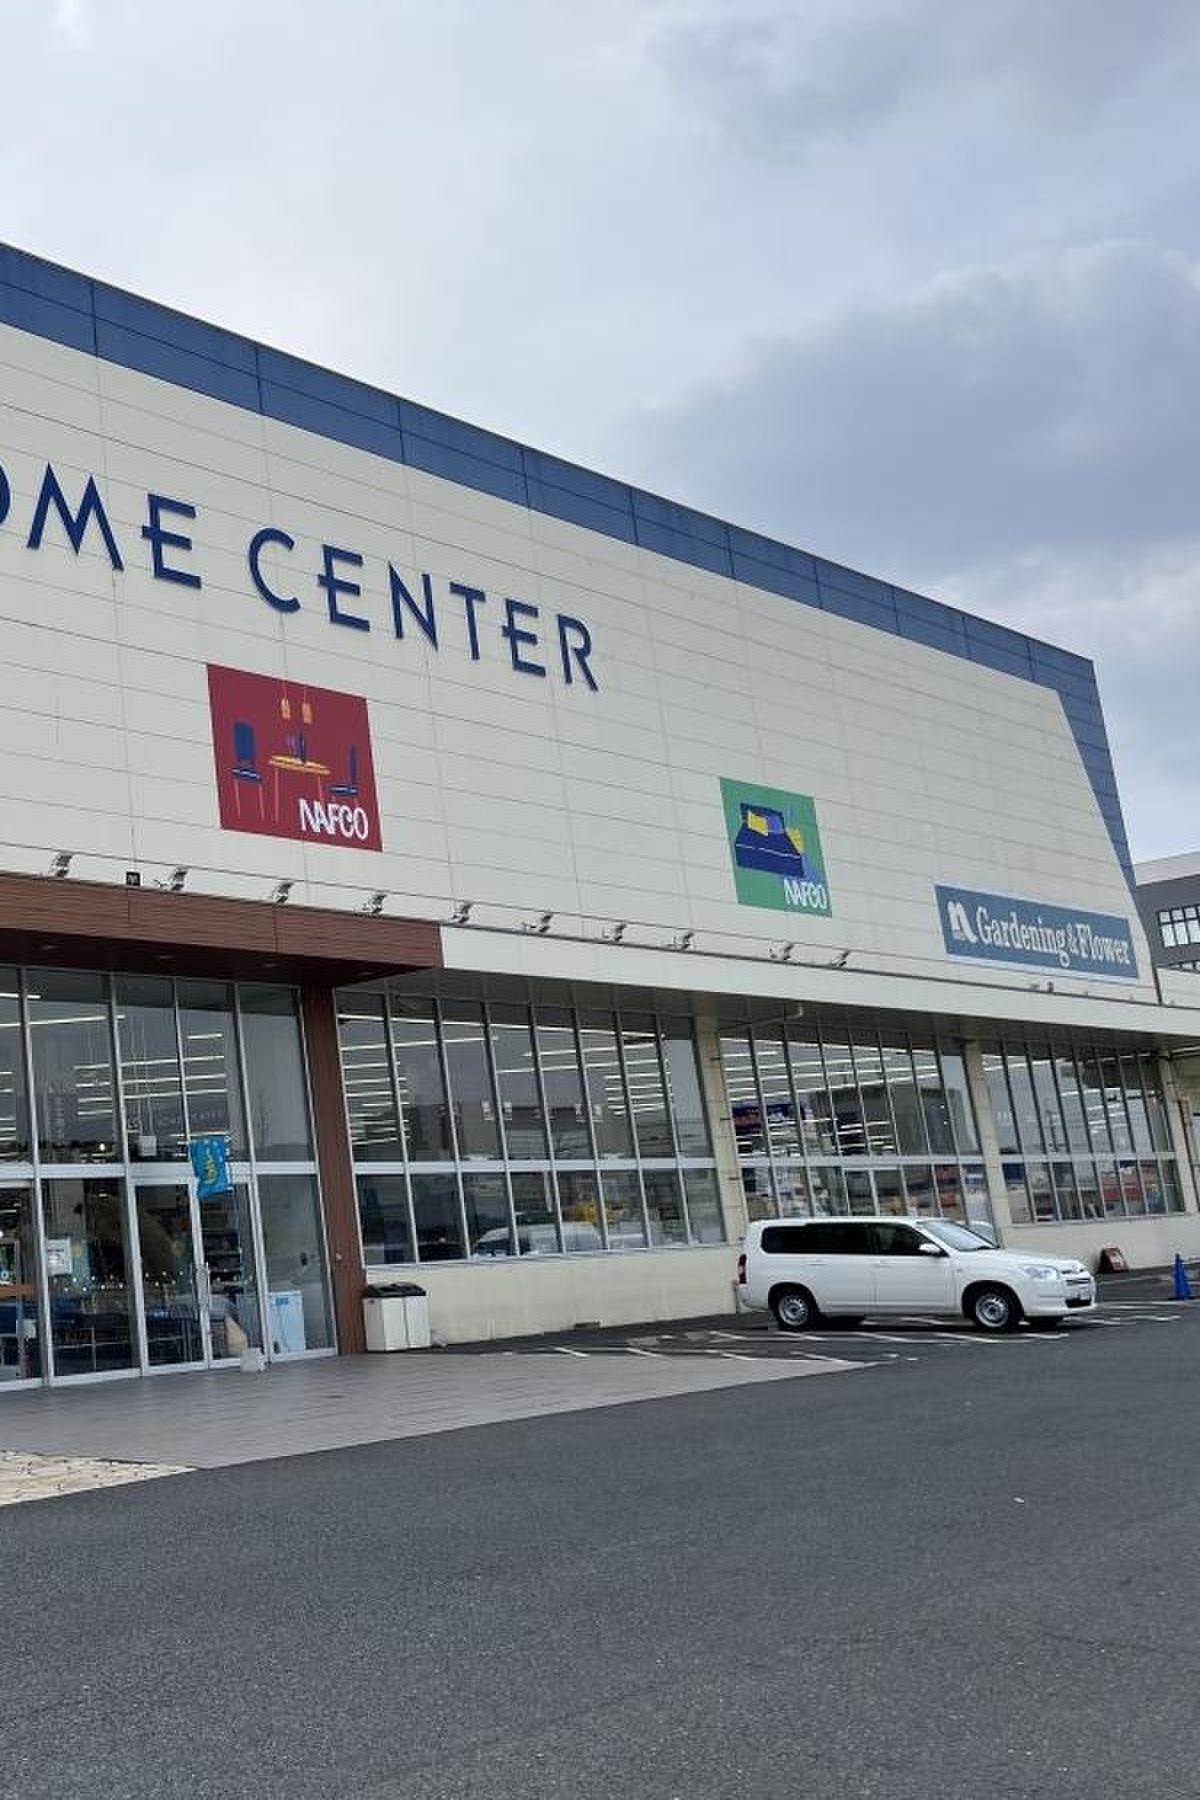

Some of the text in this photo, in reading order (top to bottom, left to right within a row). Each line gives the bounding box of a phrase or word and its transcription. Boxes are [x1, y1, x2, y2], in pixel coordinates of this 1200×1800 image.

[248, 527, 600, 692] CENTER
[299, 797, 369, 840] NAFCO
[783, 877, 828, 910] NAFCO
